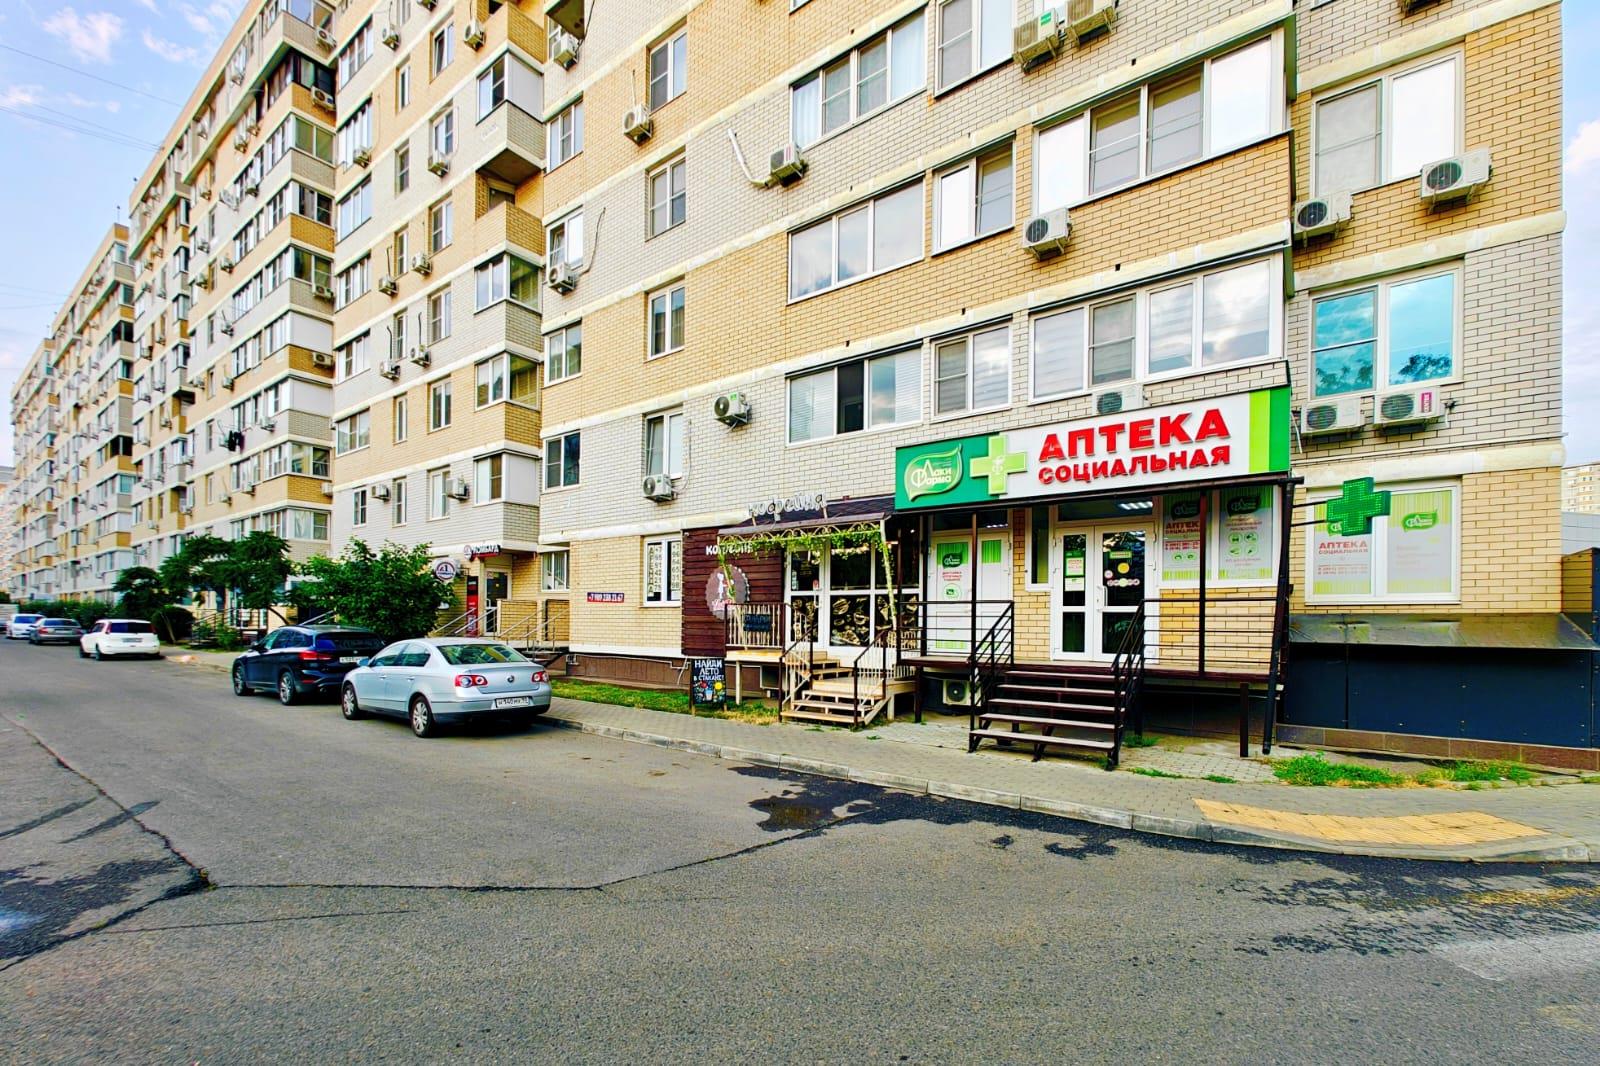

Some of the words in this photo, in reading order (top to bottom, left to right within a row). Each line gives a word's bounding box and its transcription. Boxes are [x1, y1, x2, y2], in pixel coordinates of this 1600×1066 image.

[1039, 408, 1230, 462] АПТЕКА
[1038, 445, 1230, 484] СОЦИАЛЬНАЯ
[1319, 540, 1368, 549] АПТЕКА
[694, 659, 722, 668] НАЙДИ
[700, 667, 720, 675] ЛЕТО
